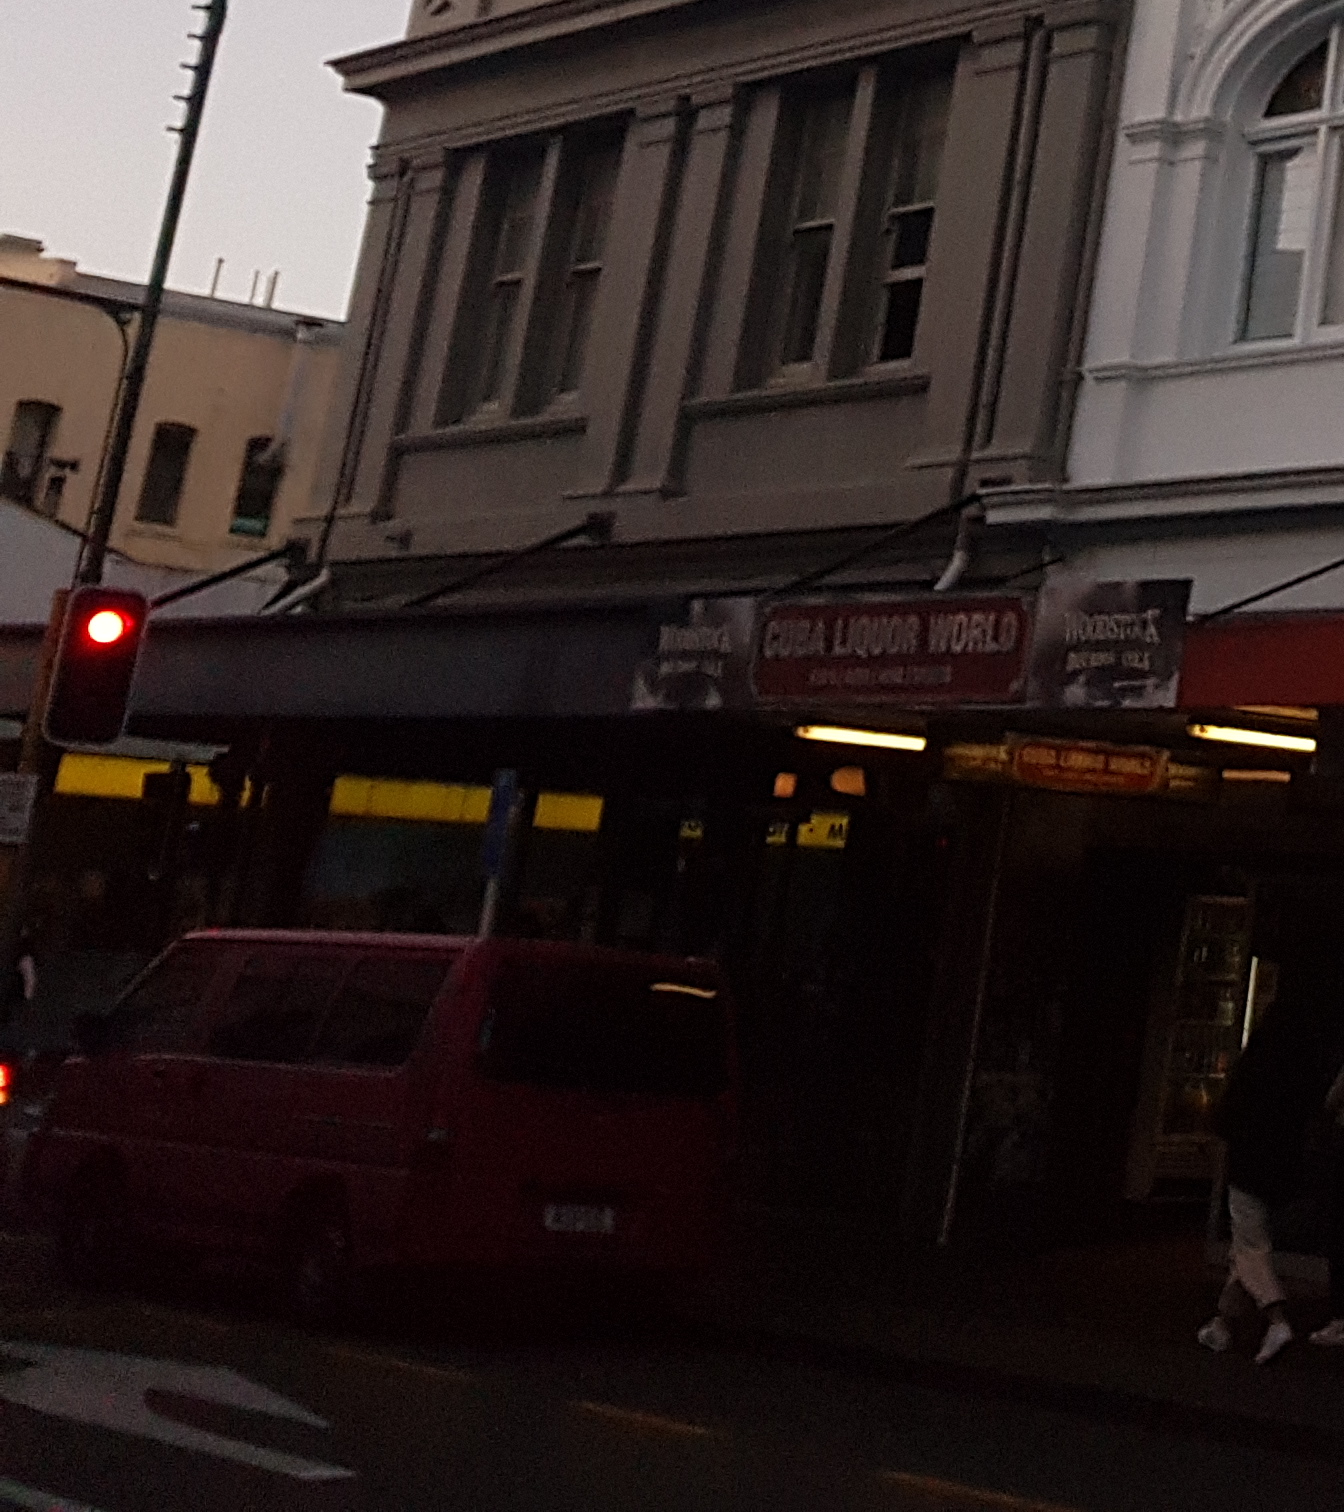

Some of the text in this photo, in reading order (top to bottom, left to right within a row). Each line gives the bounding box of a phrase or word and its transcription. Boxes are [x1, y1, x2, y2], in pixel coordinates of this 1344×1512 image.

[764, 611, 1020, 659] CUBA LIQUOR WORLD
